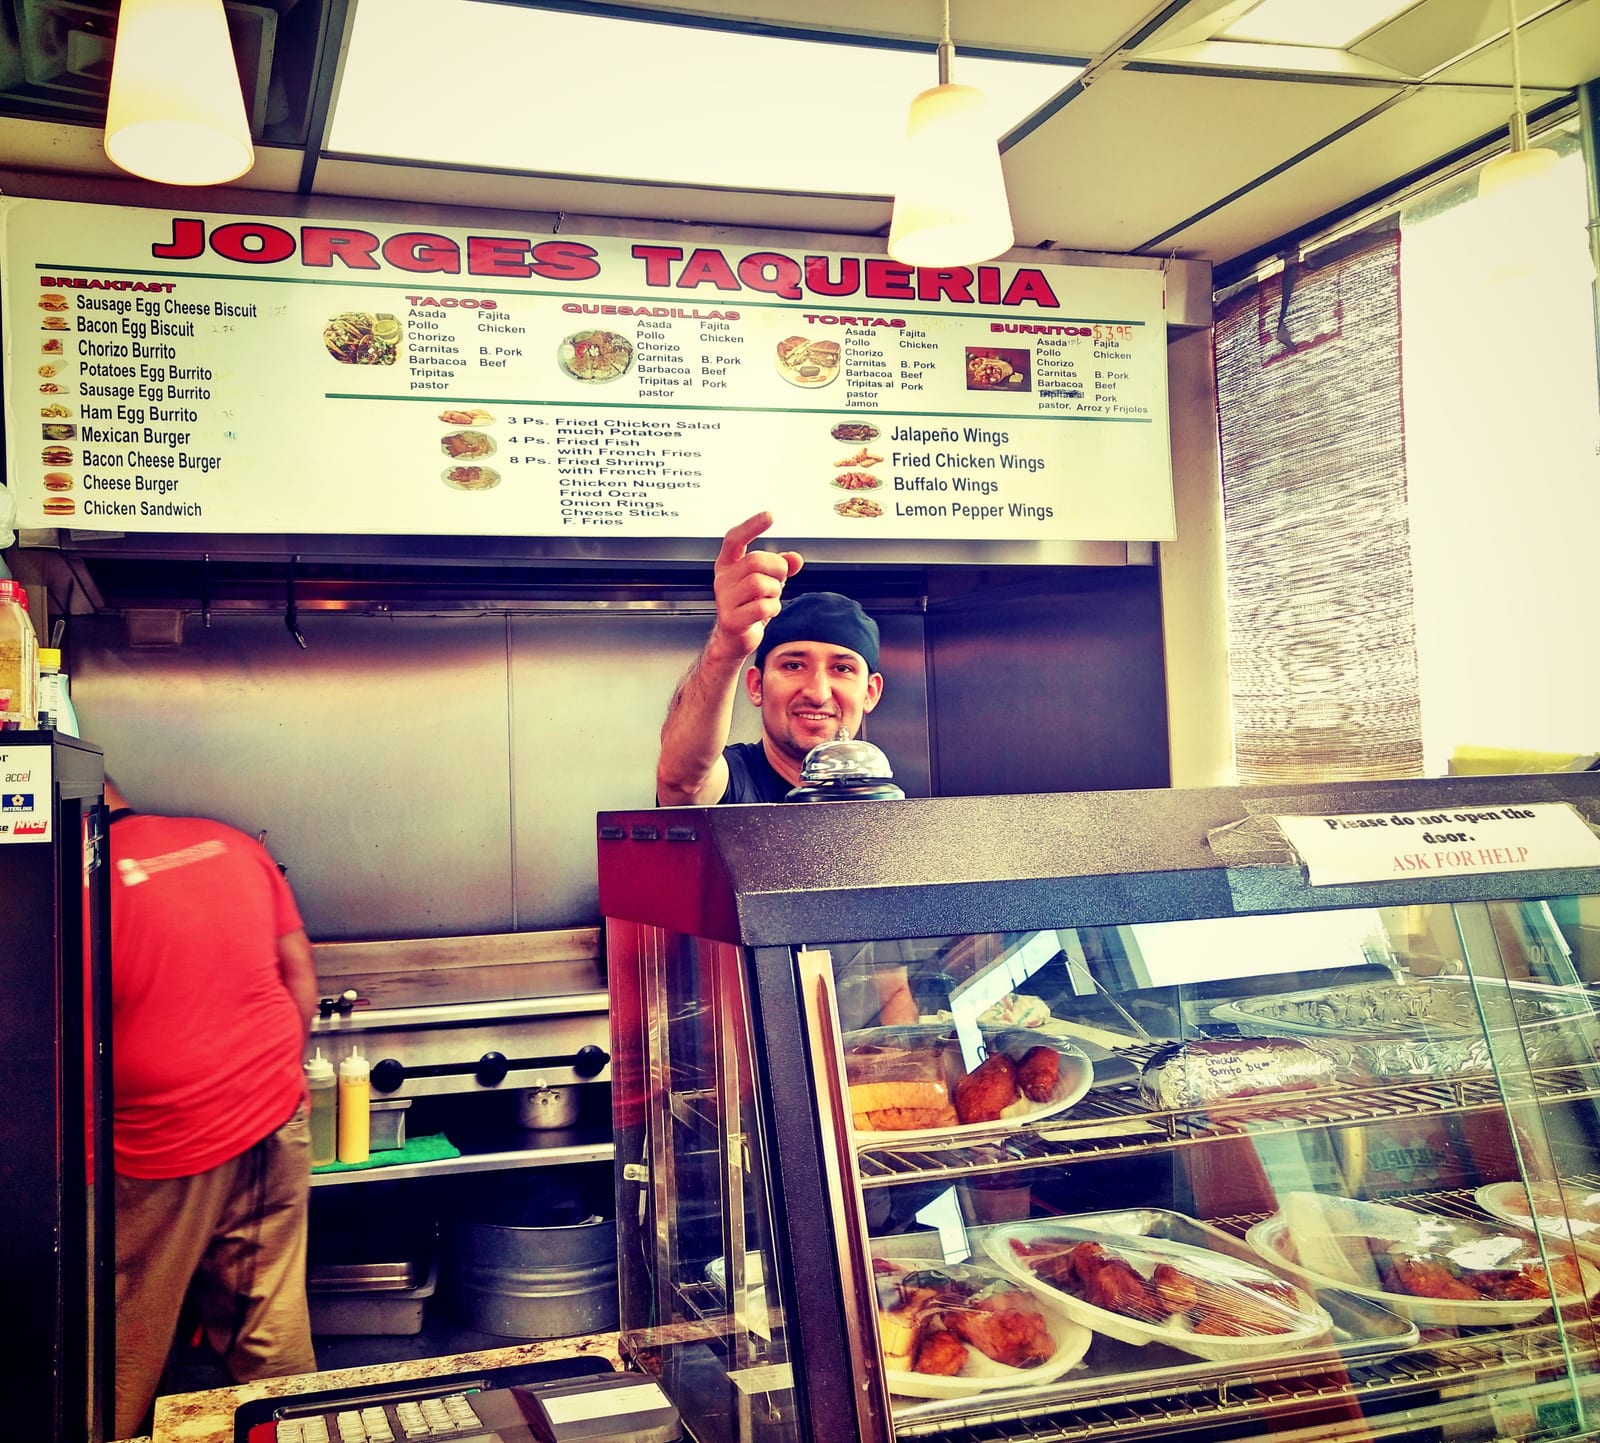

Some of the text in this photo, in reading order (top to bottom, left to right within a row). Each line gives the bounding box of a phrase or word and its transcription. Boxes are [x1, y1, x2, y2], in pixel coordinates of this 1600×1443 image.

[151, 218, 1061, 308] JORGES TAQUERIA
[40, 276, 176, 293] BREAKFAST
[77, 295, 131, 315] Sausage
[136, 298, 162, 316] Egg
[165, 299, 210, 315] Cheese
[215, 302, 257, 317] Biscuit
[405, 296, 497, 310] TACOS
[409, 309, 446, 318] Asada
[479, 311, 510, 321] Fajita
[562, 303, 740, 320] QUESADILLAS
[408, 320, 438, 329] Pollo
[638, 320, 671, 328] Asada
[803, 314, 906, 328] TORTAS
[76, 316, 118, 333] Bacon
[121, 317, 146, 339] Egg
[150, 319, 195, 337] Biscuit
[478, 324, 525, 333] Chicken
[701, 321, 729, 331] Fajita
[991, 323, 1092, 336] BURRITOS
[637, 331, 665, 339] Pollo
[846, 328, 876, 336] Asada
[900, 329, 925, 338] Fajita
[409, 332, 455, 342] Chorizo
[700, 334, 743, 343] Chicken
[637, 342, 680, 351] Chorizo
[845, 338, 870, 346] Pollo
[899, 341, 938, 349] Chicken
[1037, 338, 1067, 346] Asada
[1093, 339, 1120, 350] Fajita
[79, 340, 175, 359] Chorizo Burrito
[409, 344, 459, 353] Carnitas
[496, 347, 522, 356] Pork
[845, 349, 883, 357] Chorizo
[638, 353, 683, 362] Carnitas
[1094, 351, 1131, 359] Chicken
[410, 356, 466, 366] Barbacoa
[480, 359, 506, 367] Beef
[716, 356, 741, 364] Pork
[846, 359, 886, 367] Carnitas
[1037, 359, 1074, 367] Chorizo
[638, 365, 690, 374] Barbacoa
[914, 361, 935, 369] Pork
[80, 362, 212, 382] Potatoes Egg Burrito
[410, 368, 454, 378] Tripitas
[702, 367, 726, 375] Beef
[846, 369, 892, 378] Barbacoa
[1037, 369, 1077, 377] Carnitas
[410, 382, 449, 390] pastor
[639, 377, 679, 386] Tripitas
[702, 380, 726, 388] Pork
[847, 379, 882, 388] Tripitas
[1038, 380, 1083, 388] Barbacoa
[80, 382, 210, 401] Sausage Egg Burrito
[639, 390, 674, 398] pastor
[1096, 394, 1117, 402] Pork
[81, 404, 197, 424] Ham Egg Burrito
[1114, 405, 1147, 414] Frijoles
[604, 420, 670, 428] Chicken
[82, 427, 190, 448] Mexican Burger
[610, 429, 682, 437] Potatoes
[891, 426, 1009, 447] Jalapeño Wings
[556, 437, 599, 446] Fried
[605, 438, 640, 447] Fish
[557, 447, 593, 455] with
[599, 448, 656, 457] French
[83, 450, 221, 473] Bacon Cheese Burger
[558, 458, 599, 468] Fried
[606, 459, 664, 468] Shrimp
[893, 453, 1045, 472] Fried Chicken Wings
[558, 467, 593, 475] with
[599, 467, 657, 476] French
[84, 475, 178, 495] Cheese Burger
[559, 479, 700, 489] Chicken Nuggets
[894, 477, 998, 495] Buffalo Wings
[560, 489, 602, 497] Fried
[84, 500, 201, 516] Chicken Sandwich
[616, 500, 664, 508] Rings
[896, 502, 1053, 521] Lemon Pepper Wings
[5, 770, 31, 782] accel
[1324, 807, 1535, 830] Please do not open the
[16, 820, 47, 829] NYCE
[1393, 847, 1528, 872] ASK FOR HELP
[1205, 1056, 1242, 1067] Chicken
[1208, 1065, 1242, 1076] Burrito
